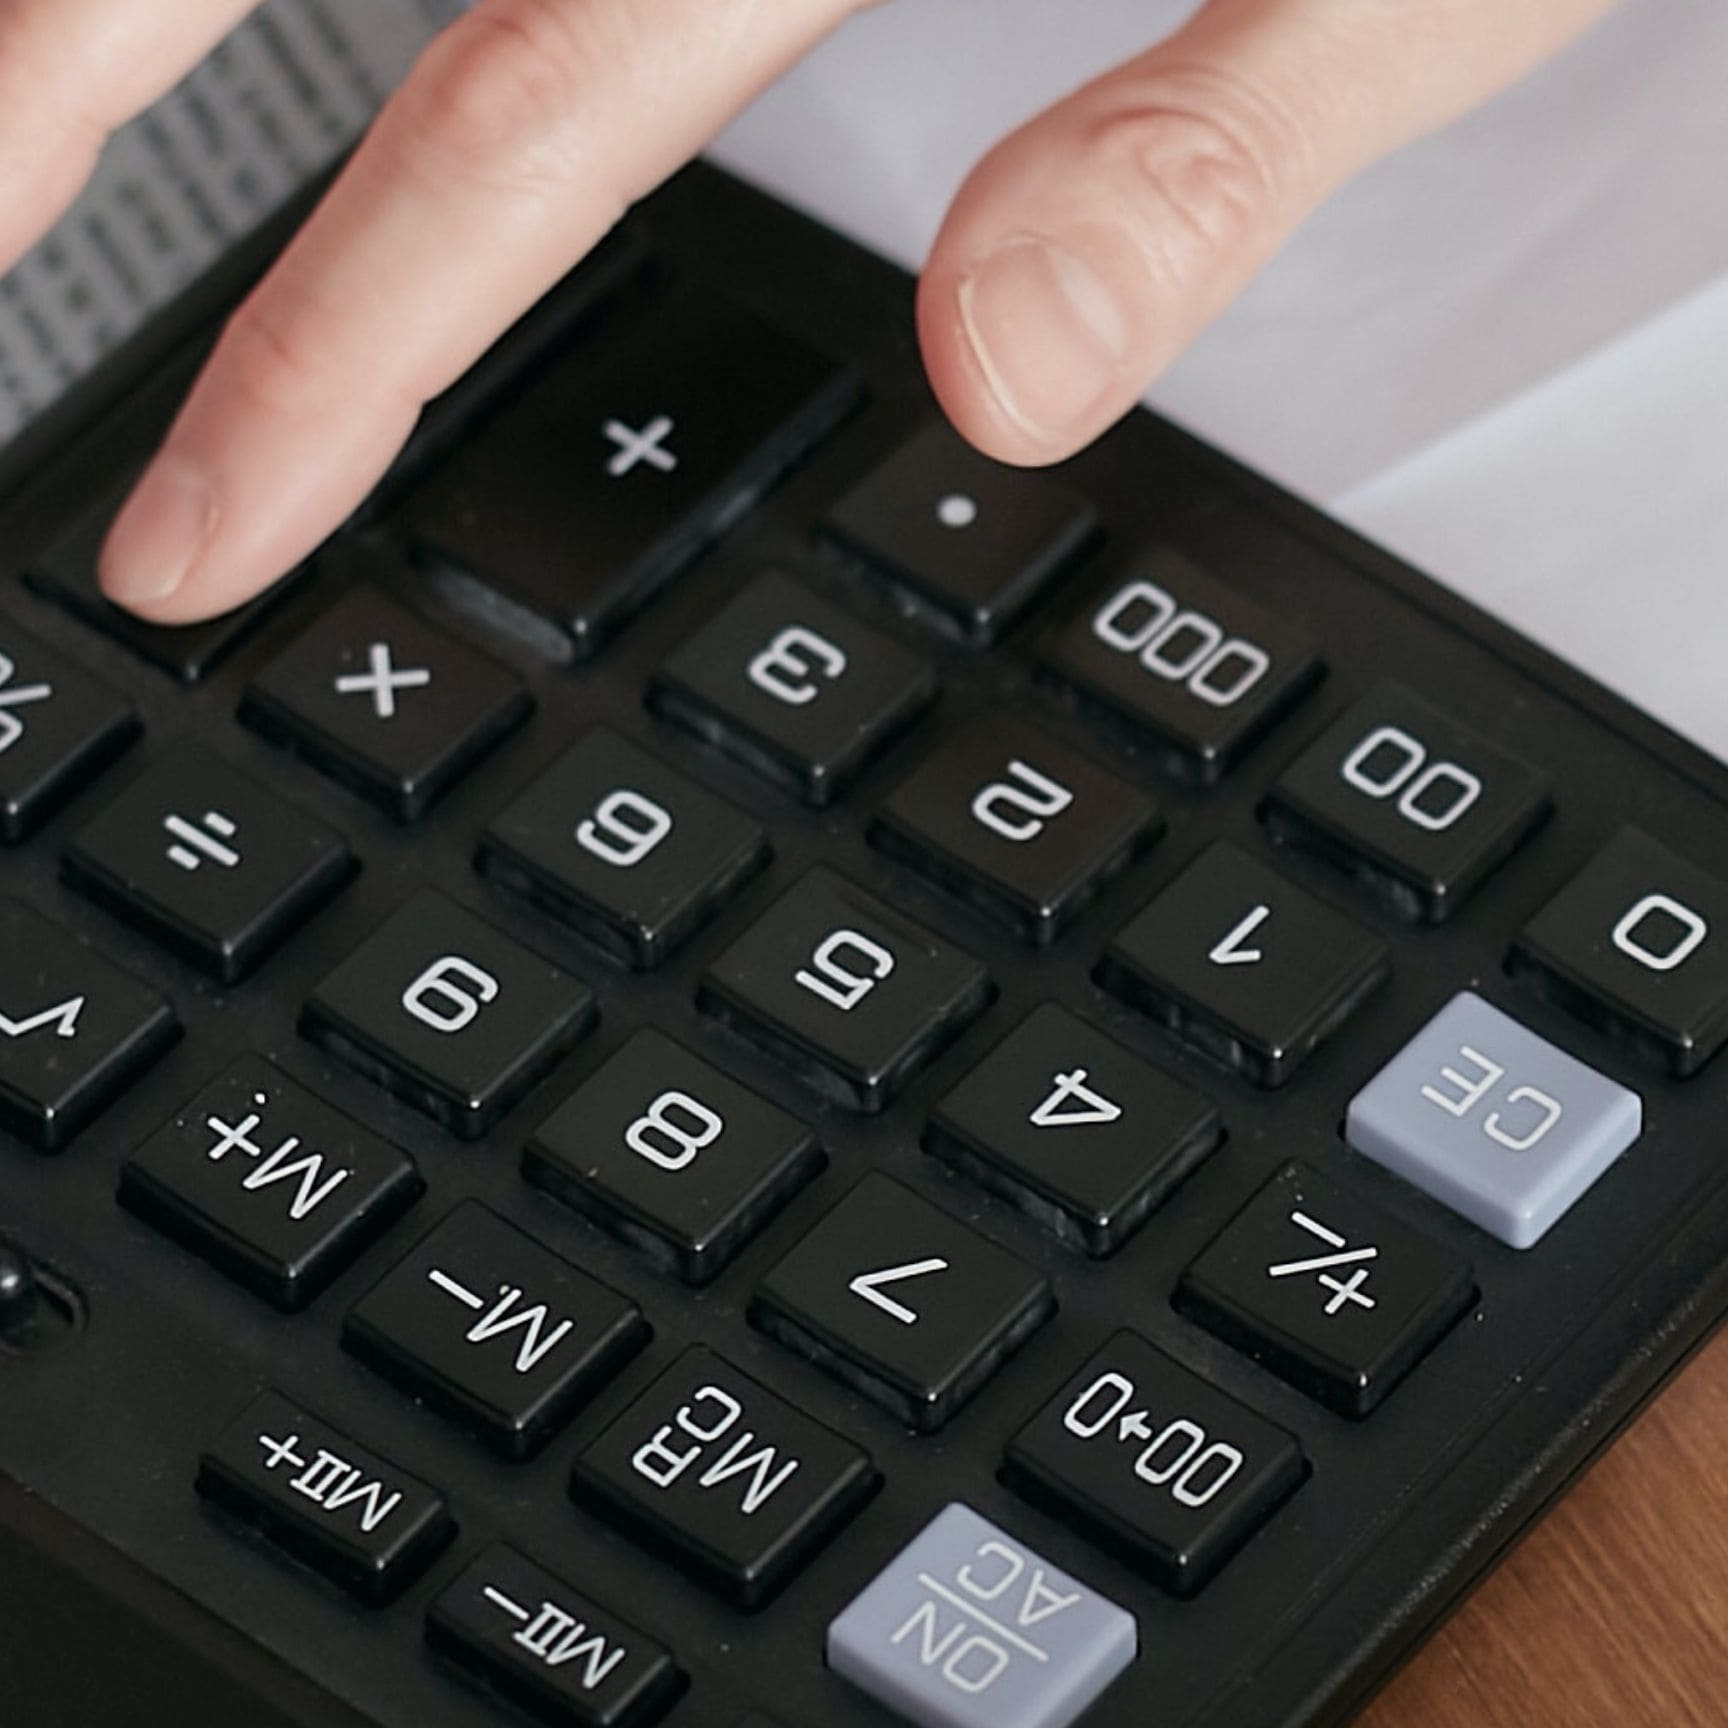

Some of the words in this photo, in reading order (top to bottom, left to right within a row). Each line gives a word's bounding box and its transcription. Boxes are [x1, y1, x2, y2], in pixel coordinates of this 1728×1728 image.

[748, 627, 846, 704] 3
[1093, 581, 1270, 706] 000
[972, 760, 1074, 841] 2
[1341, 726, 1482, 831] 00
[575, 790, 672, 867] 6
[794, 929, 895, 1011] 5
[1208, 905, 1270, 965] 1
[1611, 894, 1707, 971] 0
[401, 955, 499, 1032] 9
[624, 1090, 724, 1171] 8
[1029, 1068, 1122, 1127] 4
[1419, 1044, 1563, 1152] CE
[848, 1257, 949, 1325] 7
[955, 1540, 1081, 1628] AC
[890, 1599, 1010, 1694] ON
